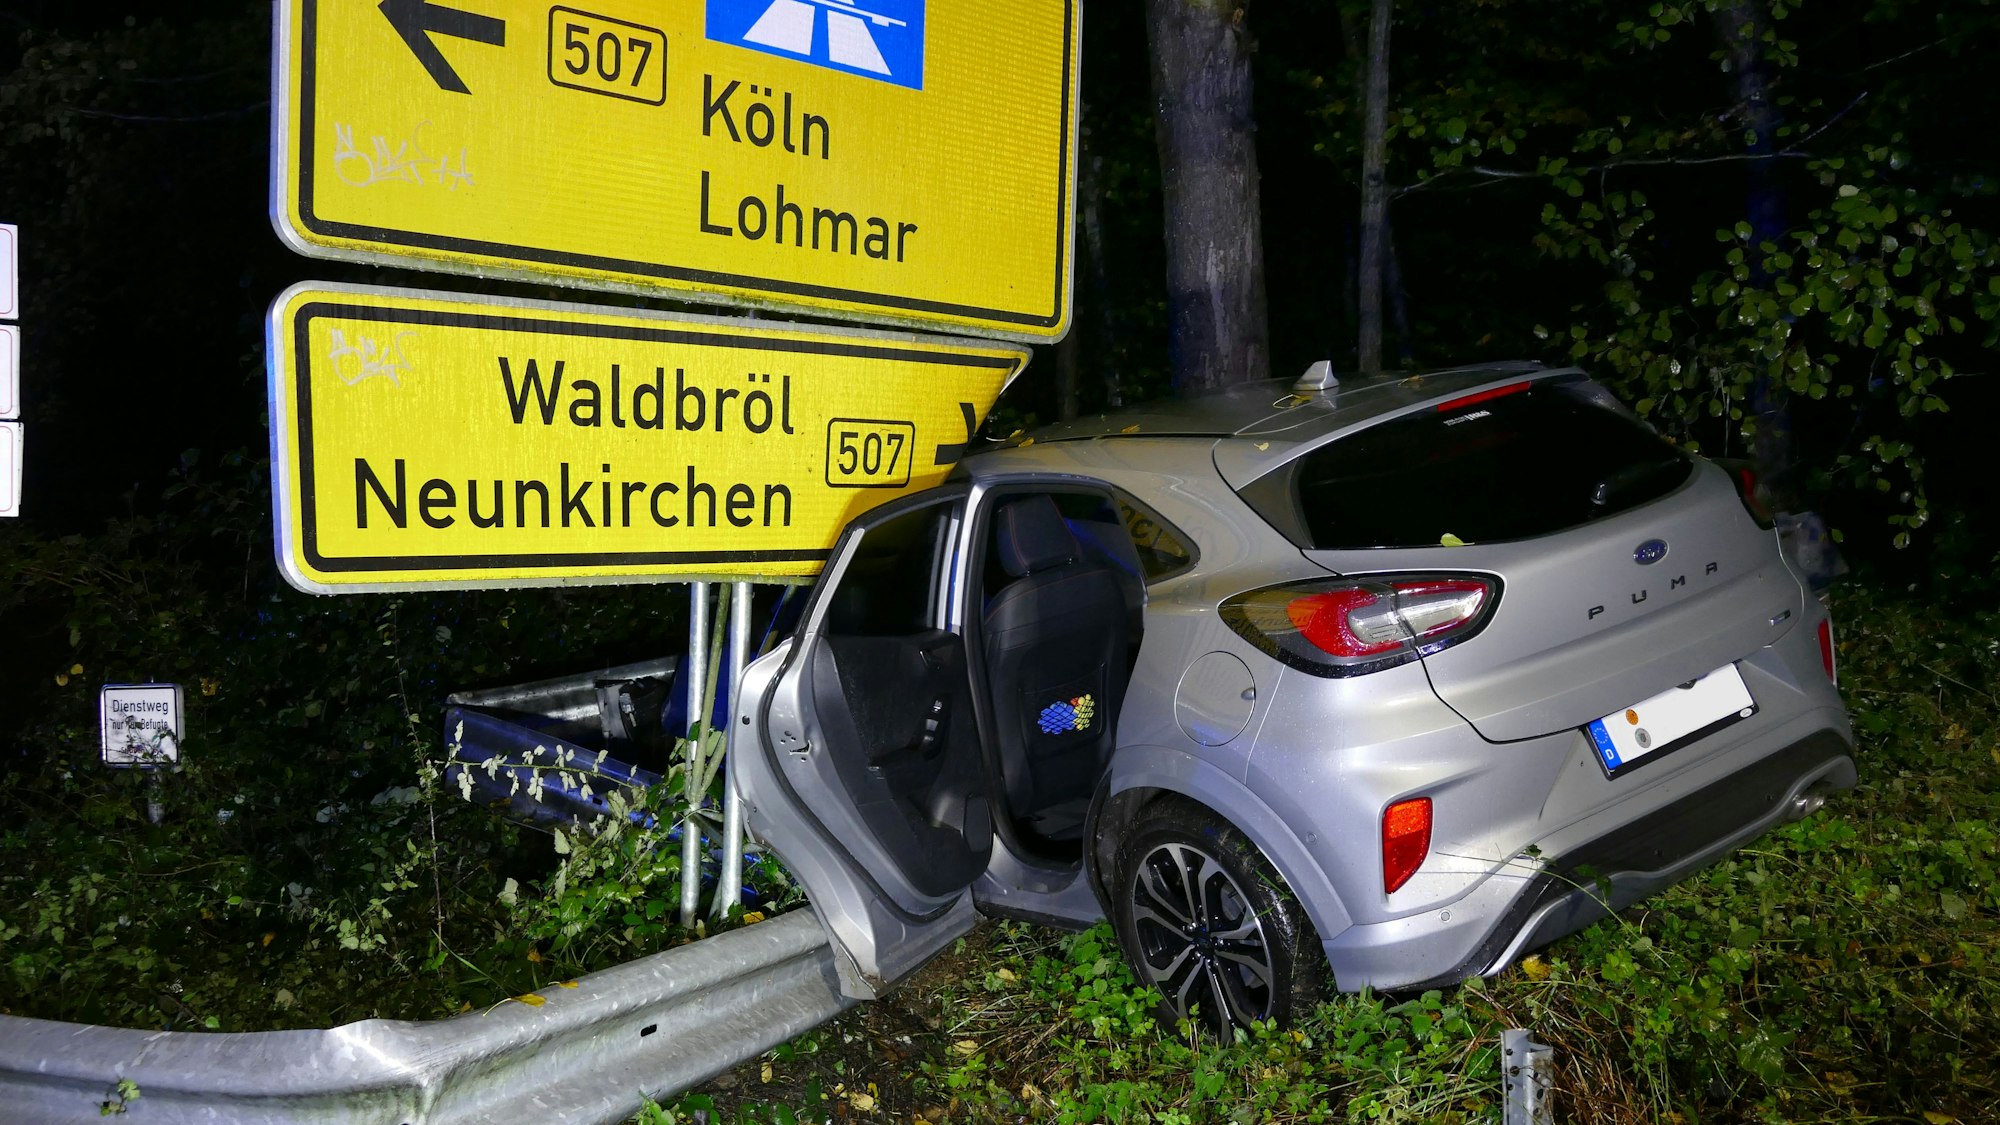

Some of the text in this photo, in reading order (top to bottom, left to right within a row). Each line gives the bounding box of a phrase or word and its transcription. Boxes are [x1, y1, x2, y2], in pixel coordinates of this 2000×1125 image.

[563, 27, 653, 88] 507
[702, 73, 830, 160] Köln
[700, 170, 919, 263] Lohmar
[498, 356, 794, 436] Waldbröl
[837, 431, 905, 477] 507
[354, 457, 793, 529] Neunkirchen
[112, 699, 169, 715] Dienstweg
[112, 720, 124, 730] nur
